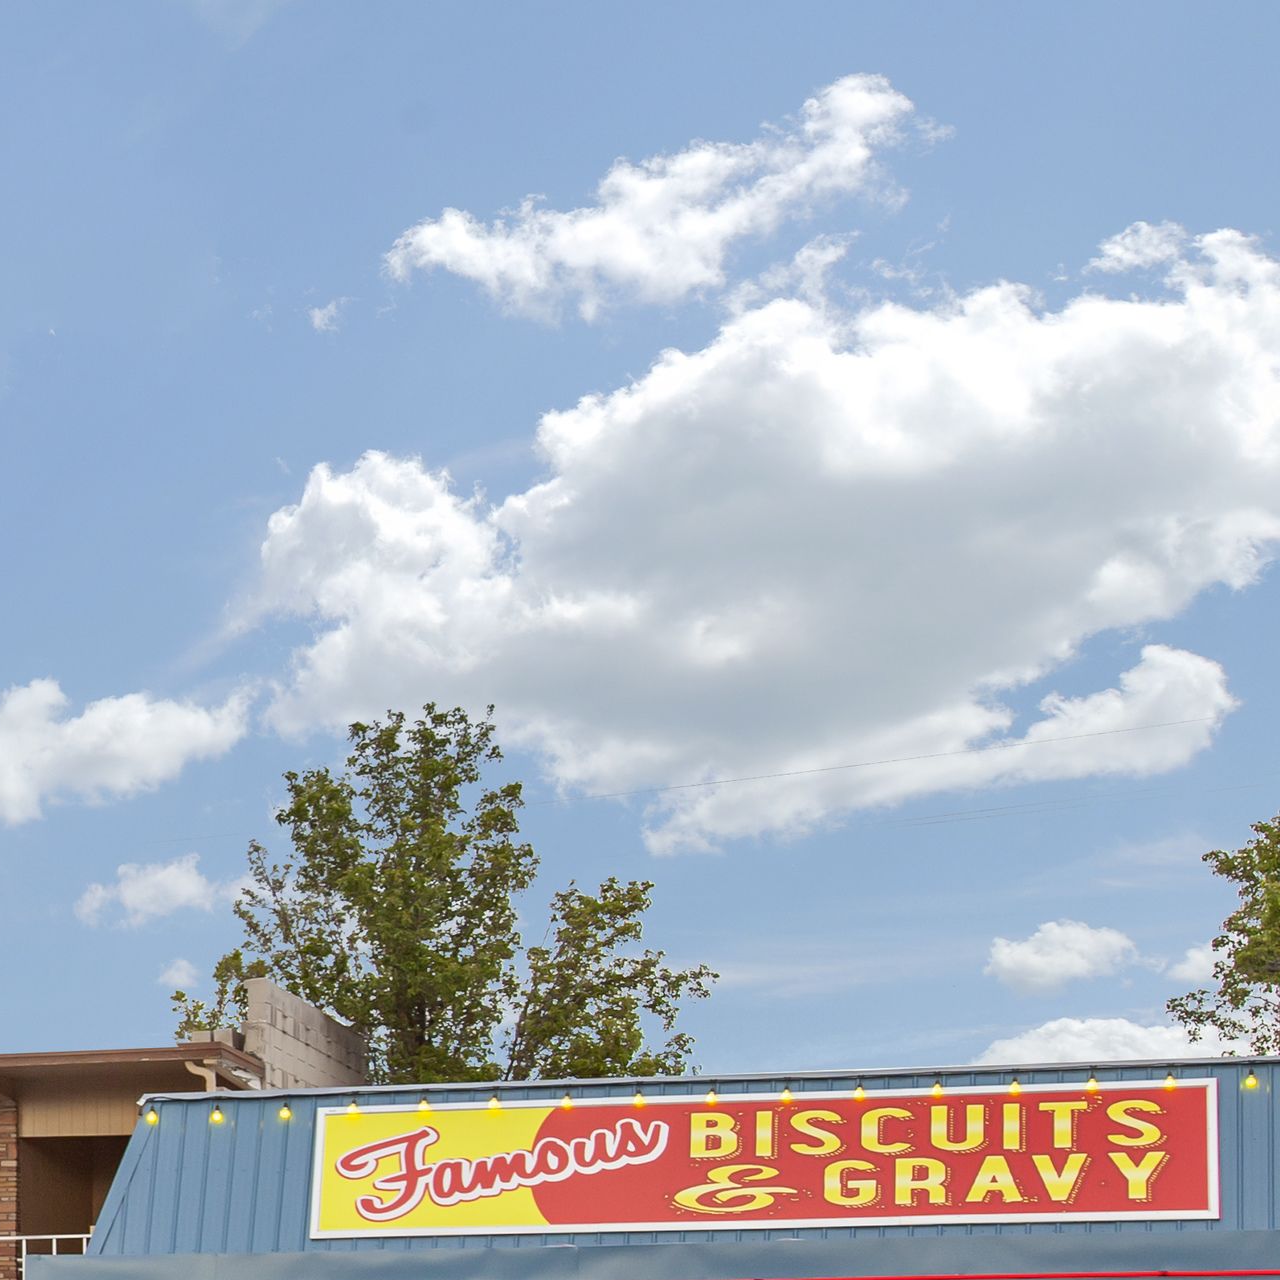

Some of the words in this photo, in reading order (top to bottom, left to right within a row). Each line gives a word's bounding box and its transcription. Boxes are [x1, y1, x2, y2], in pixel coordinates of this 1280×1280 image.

[688, 1099, 1168, 1159] BISCUITS
[336, 1118, 669, 1221] Famous
[673, 1164, 798, 1215] &
[822, 1151, 1169, 1208] GRAVY
